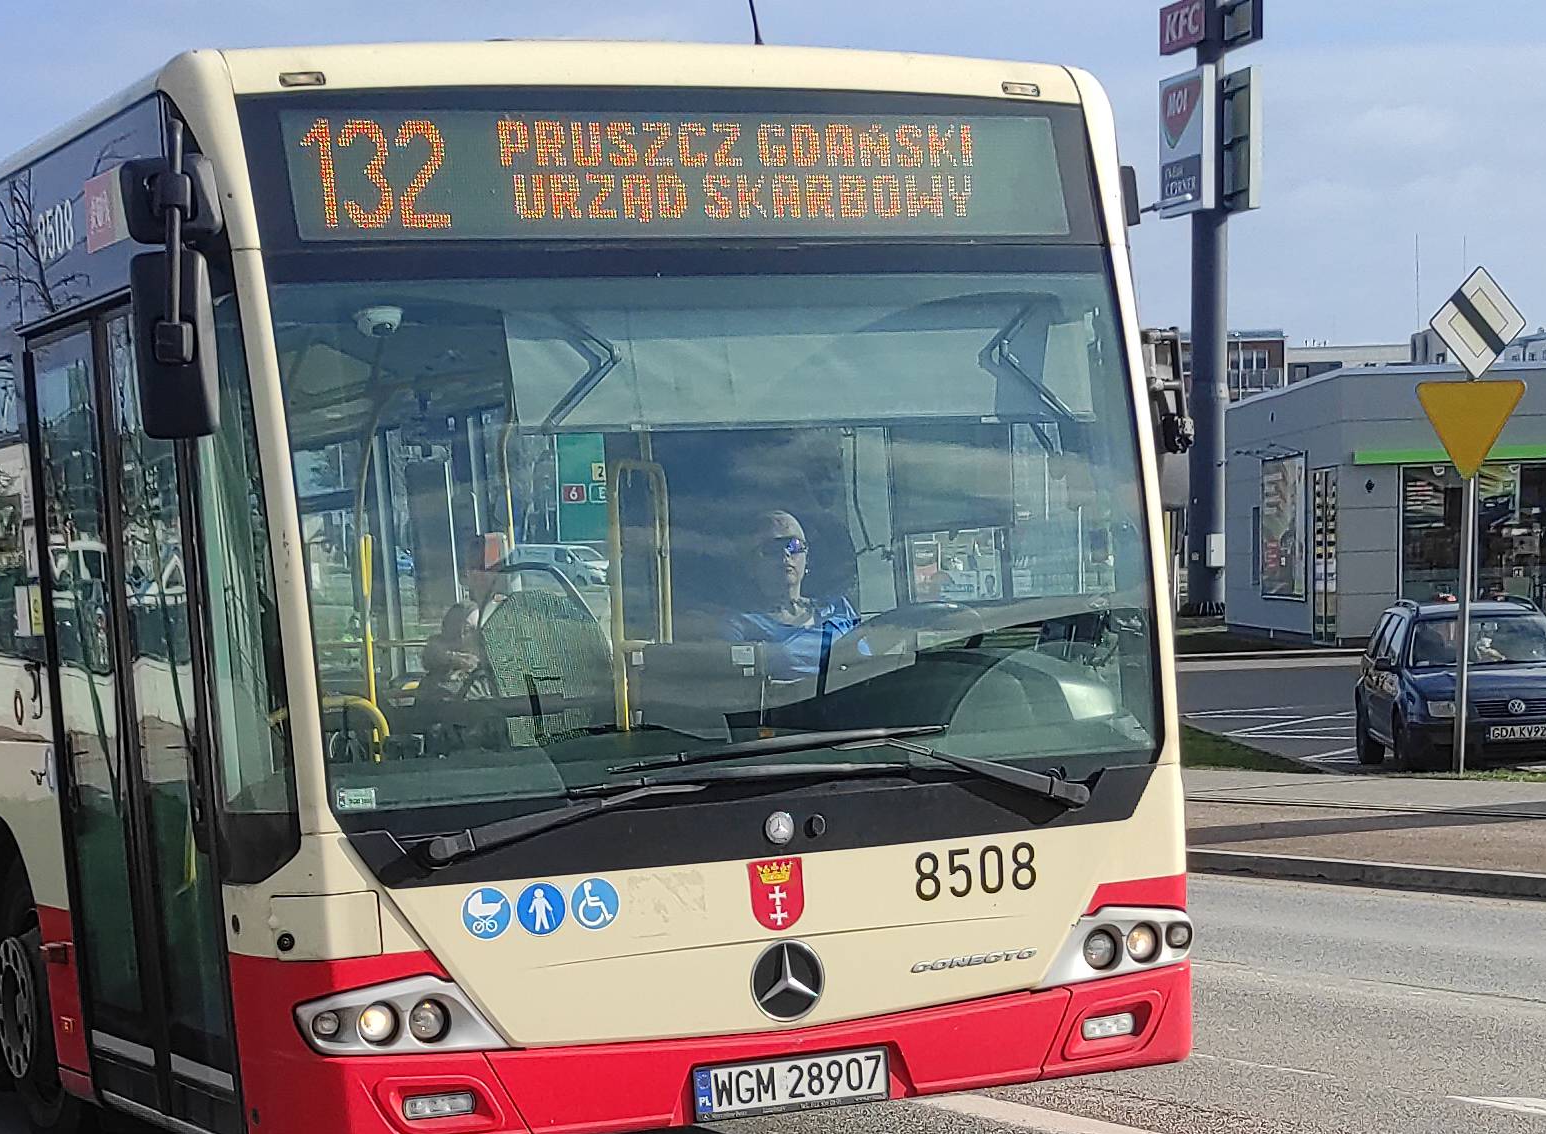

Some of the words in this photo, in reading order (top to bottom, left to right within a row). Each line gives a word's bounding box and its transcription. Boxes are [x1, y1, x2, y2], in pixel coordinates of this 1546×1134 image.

[1165, 1, 1200, 44] KFC
[497, 120, 743, 168] PRUSZCZ
[757, 123, 973, 167] GDAŃSKI
[300, 119, 451, 229] 132
[703, 174, 972, 218] SKARBOWY
[37, 199, 75, 263] 8508
[569, 486, 579, 501] 6
[1493, 727, 1516, 739] GDA
[915, 841, 1037, 902] 8508
[910, 947, 1038, 973] CONECTO
[699, 1096, 712, 1107] PL
[714, 1066, 777, 1107] WGM
[787, 1055, 881, 1099] 28907
